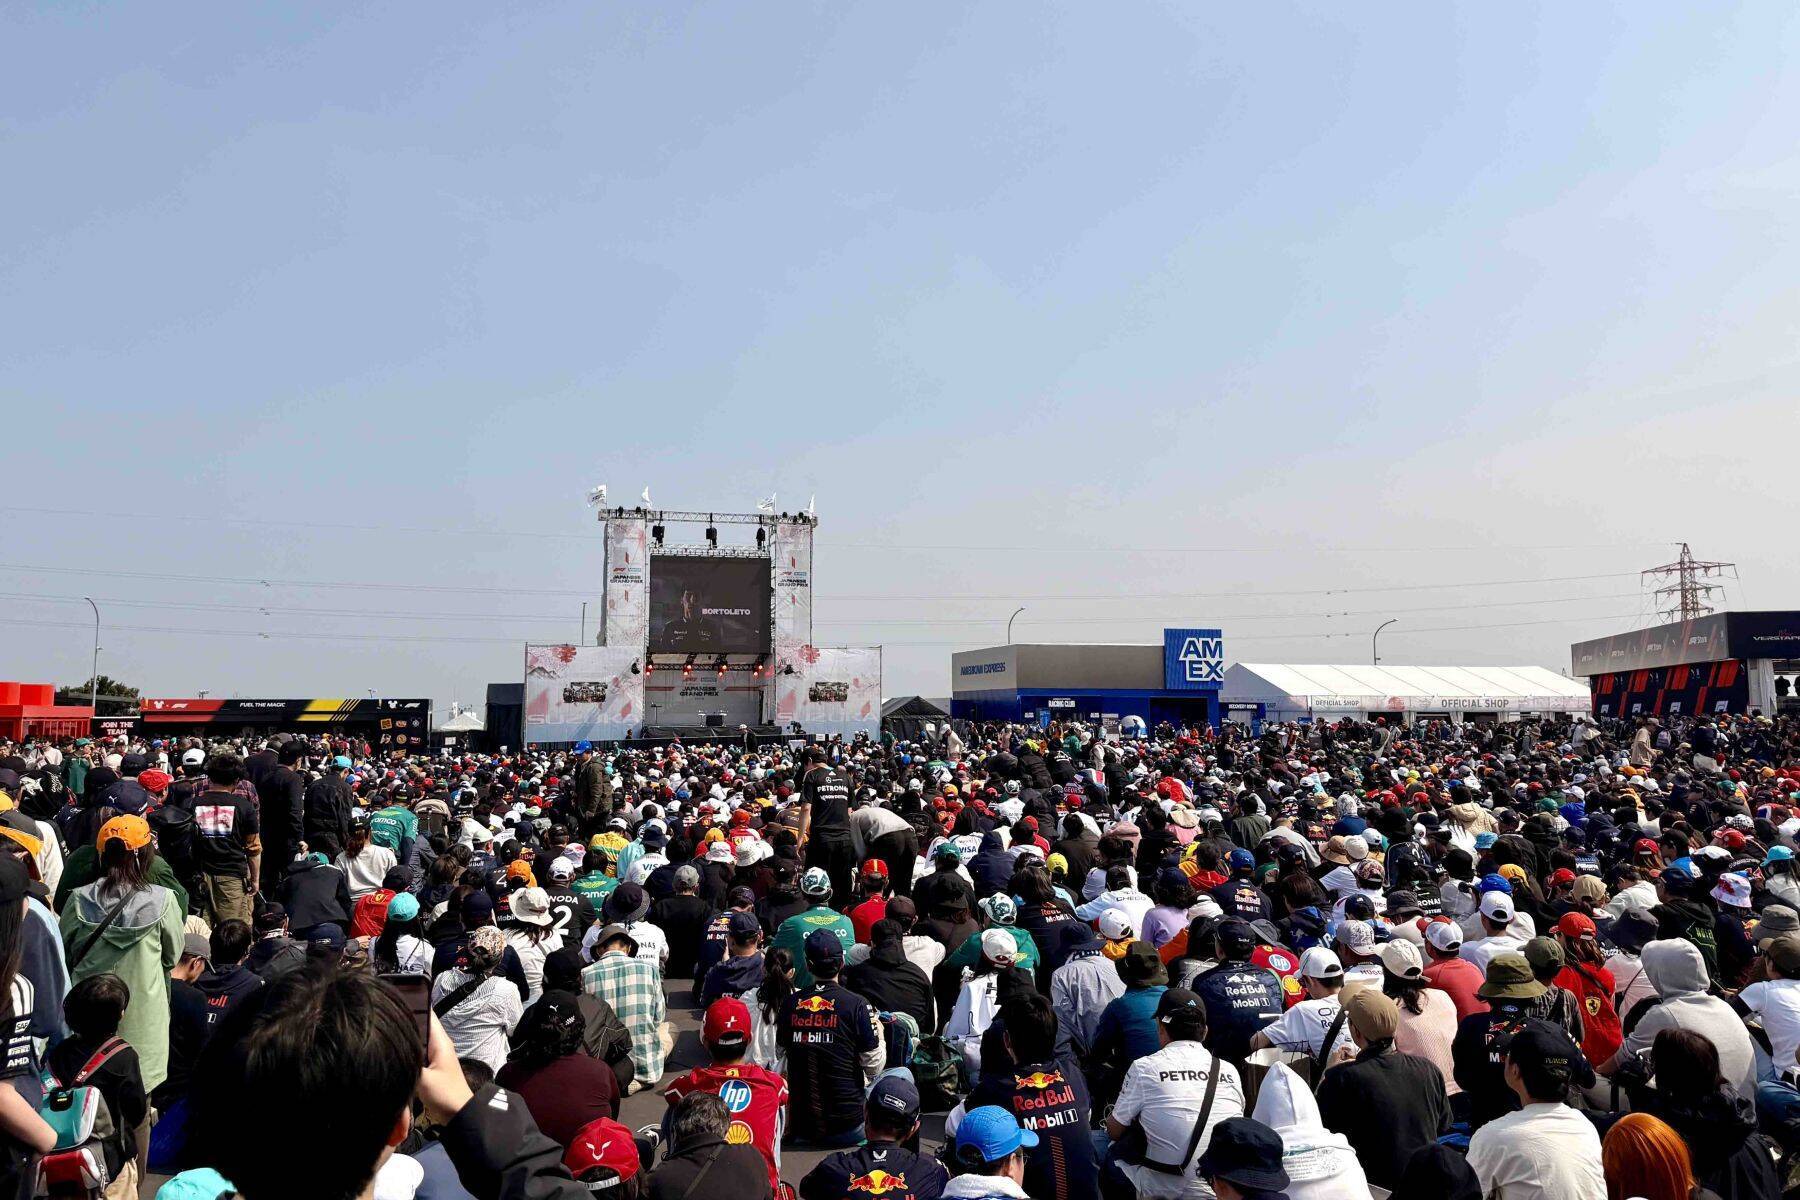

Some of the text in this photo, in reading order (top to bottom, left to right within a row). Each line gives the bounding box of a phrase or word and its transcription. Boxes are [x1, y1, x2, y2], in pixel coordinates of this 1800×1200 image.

[1181, 639, 1222, 659] AM
[983, 662, 1005, 674] EXPRESS
[1188, 660, 1223, 679] EX
[1441, 699, 1509, 708] OFFICIAL SHOP
[959, 845, 977, 853] VISA
[643, 863, 664, 871] VIS
[548, 896, 579, 905] NODA
[1225, 983, 1267, 996] Red Bull
[1232, 998, 1260, 1009] Mobil
[792, 1014, 837, 1027] Red Bull
[793, 1031, 821, 1043] Mobil
[7, 1057, 29, 1068] AMD
[725, 1081, 748, 1110] hp
[1013, 1085, 1075, 1111] Red Bull
[1023, 1111, 1064, 1131] Mobil
